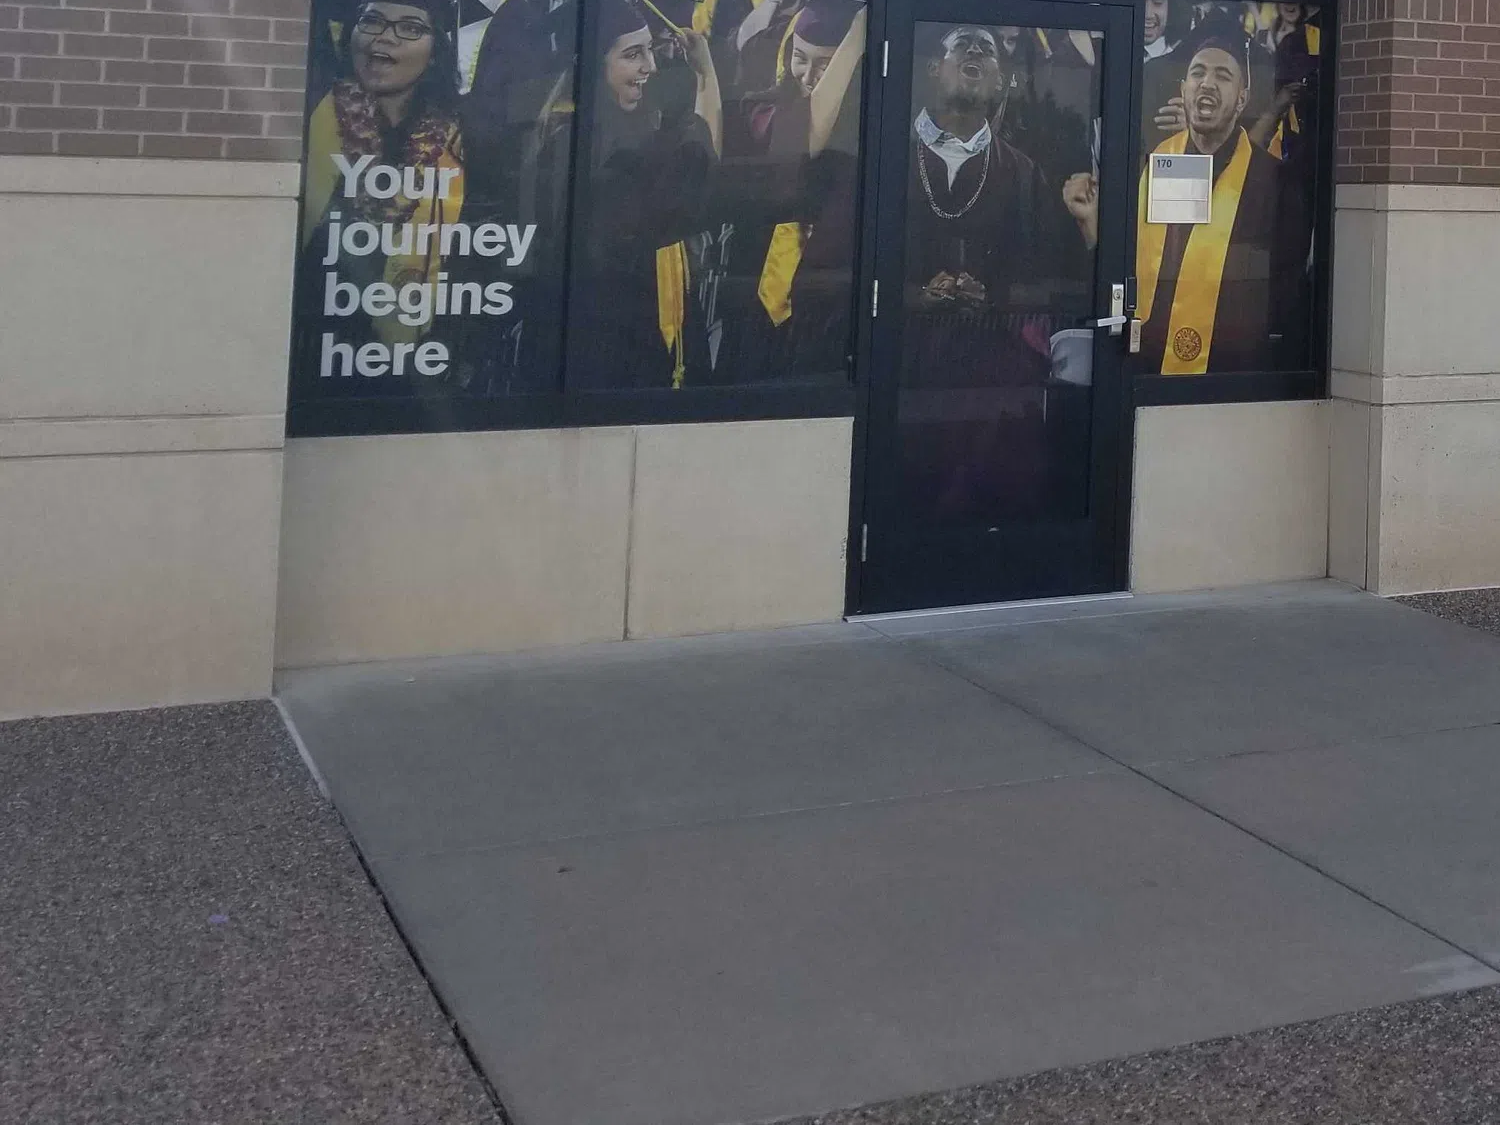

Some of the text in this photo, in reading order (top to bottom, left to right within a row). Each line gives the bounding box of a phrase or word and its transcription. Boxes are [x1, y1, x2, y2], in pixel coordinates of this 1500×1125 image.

[330, 154, 460, 200] Your
[1156, 159, 1172, 168] 170
[322, 211, 538, 266] journey
[323, 271, 514, 327] begins
[320, 332, 450, 377] here
